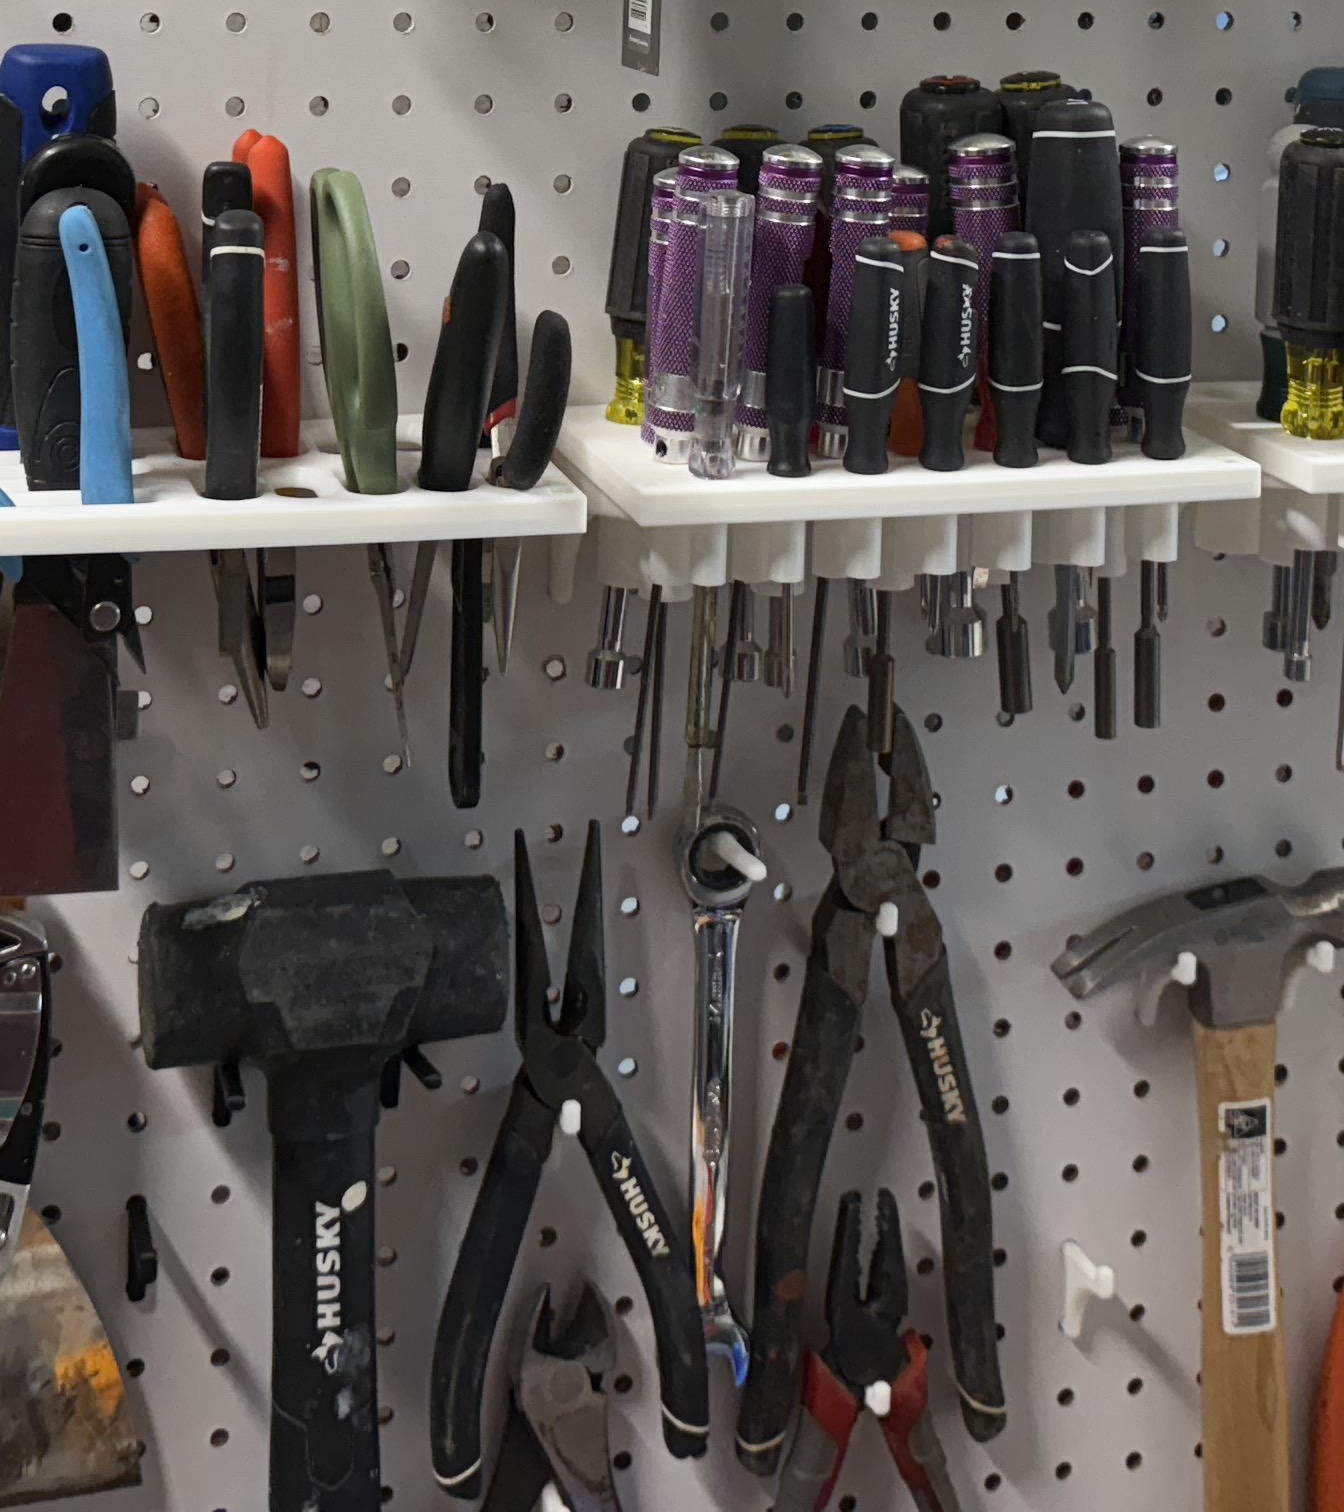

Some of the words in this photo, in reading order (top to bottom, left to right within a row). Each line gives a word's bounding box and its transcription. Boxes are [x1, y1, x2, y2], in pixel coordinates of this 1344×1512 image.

[888, 288, 900, 349] HUSKY
[927, 1036, 967, 1124] HUSKY
[620, 1177, 670, 1258] HUSKY
[315, 1200, 341, 1329] HUSKY
